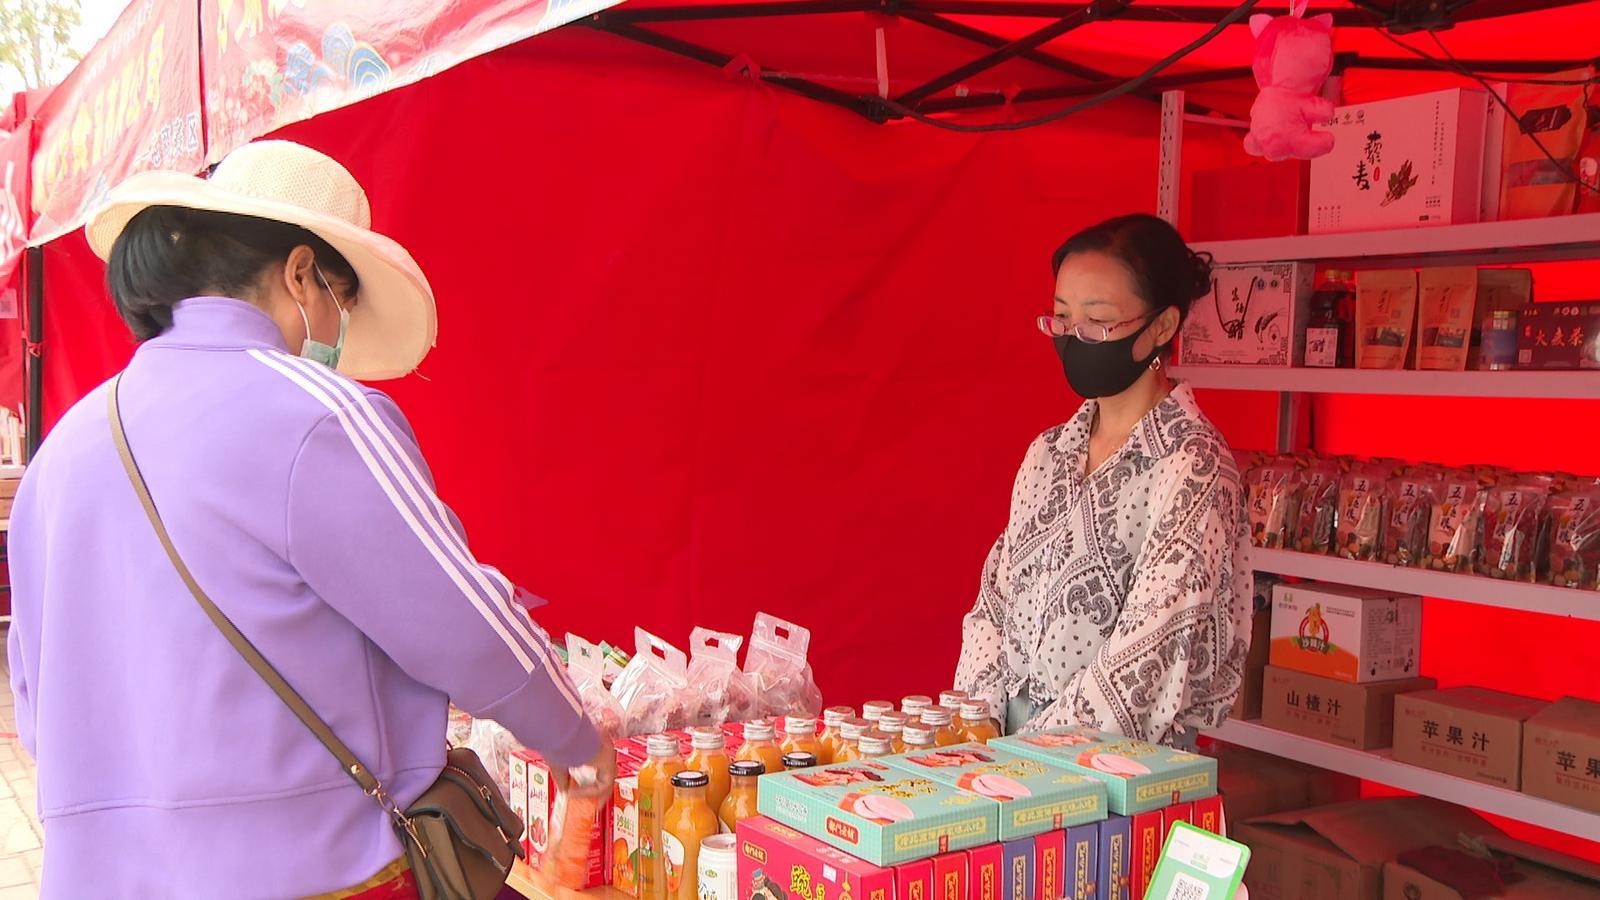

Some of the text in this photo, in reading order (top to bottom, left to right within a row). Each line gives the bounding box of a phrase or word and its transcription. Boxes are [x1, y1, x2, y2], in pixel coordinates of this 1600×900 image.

[1286, 689, 1342, 717] 山楂汁
[1421, 719, 1490, 752] 苹果汁
